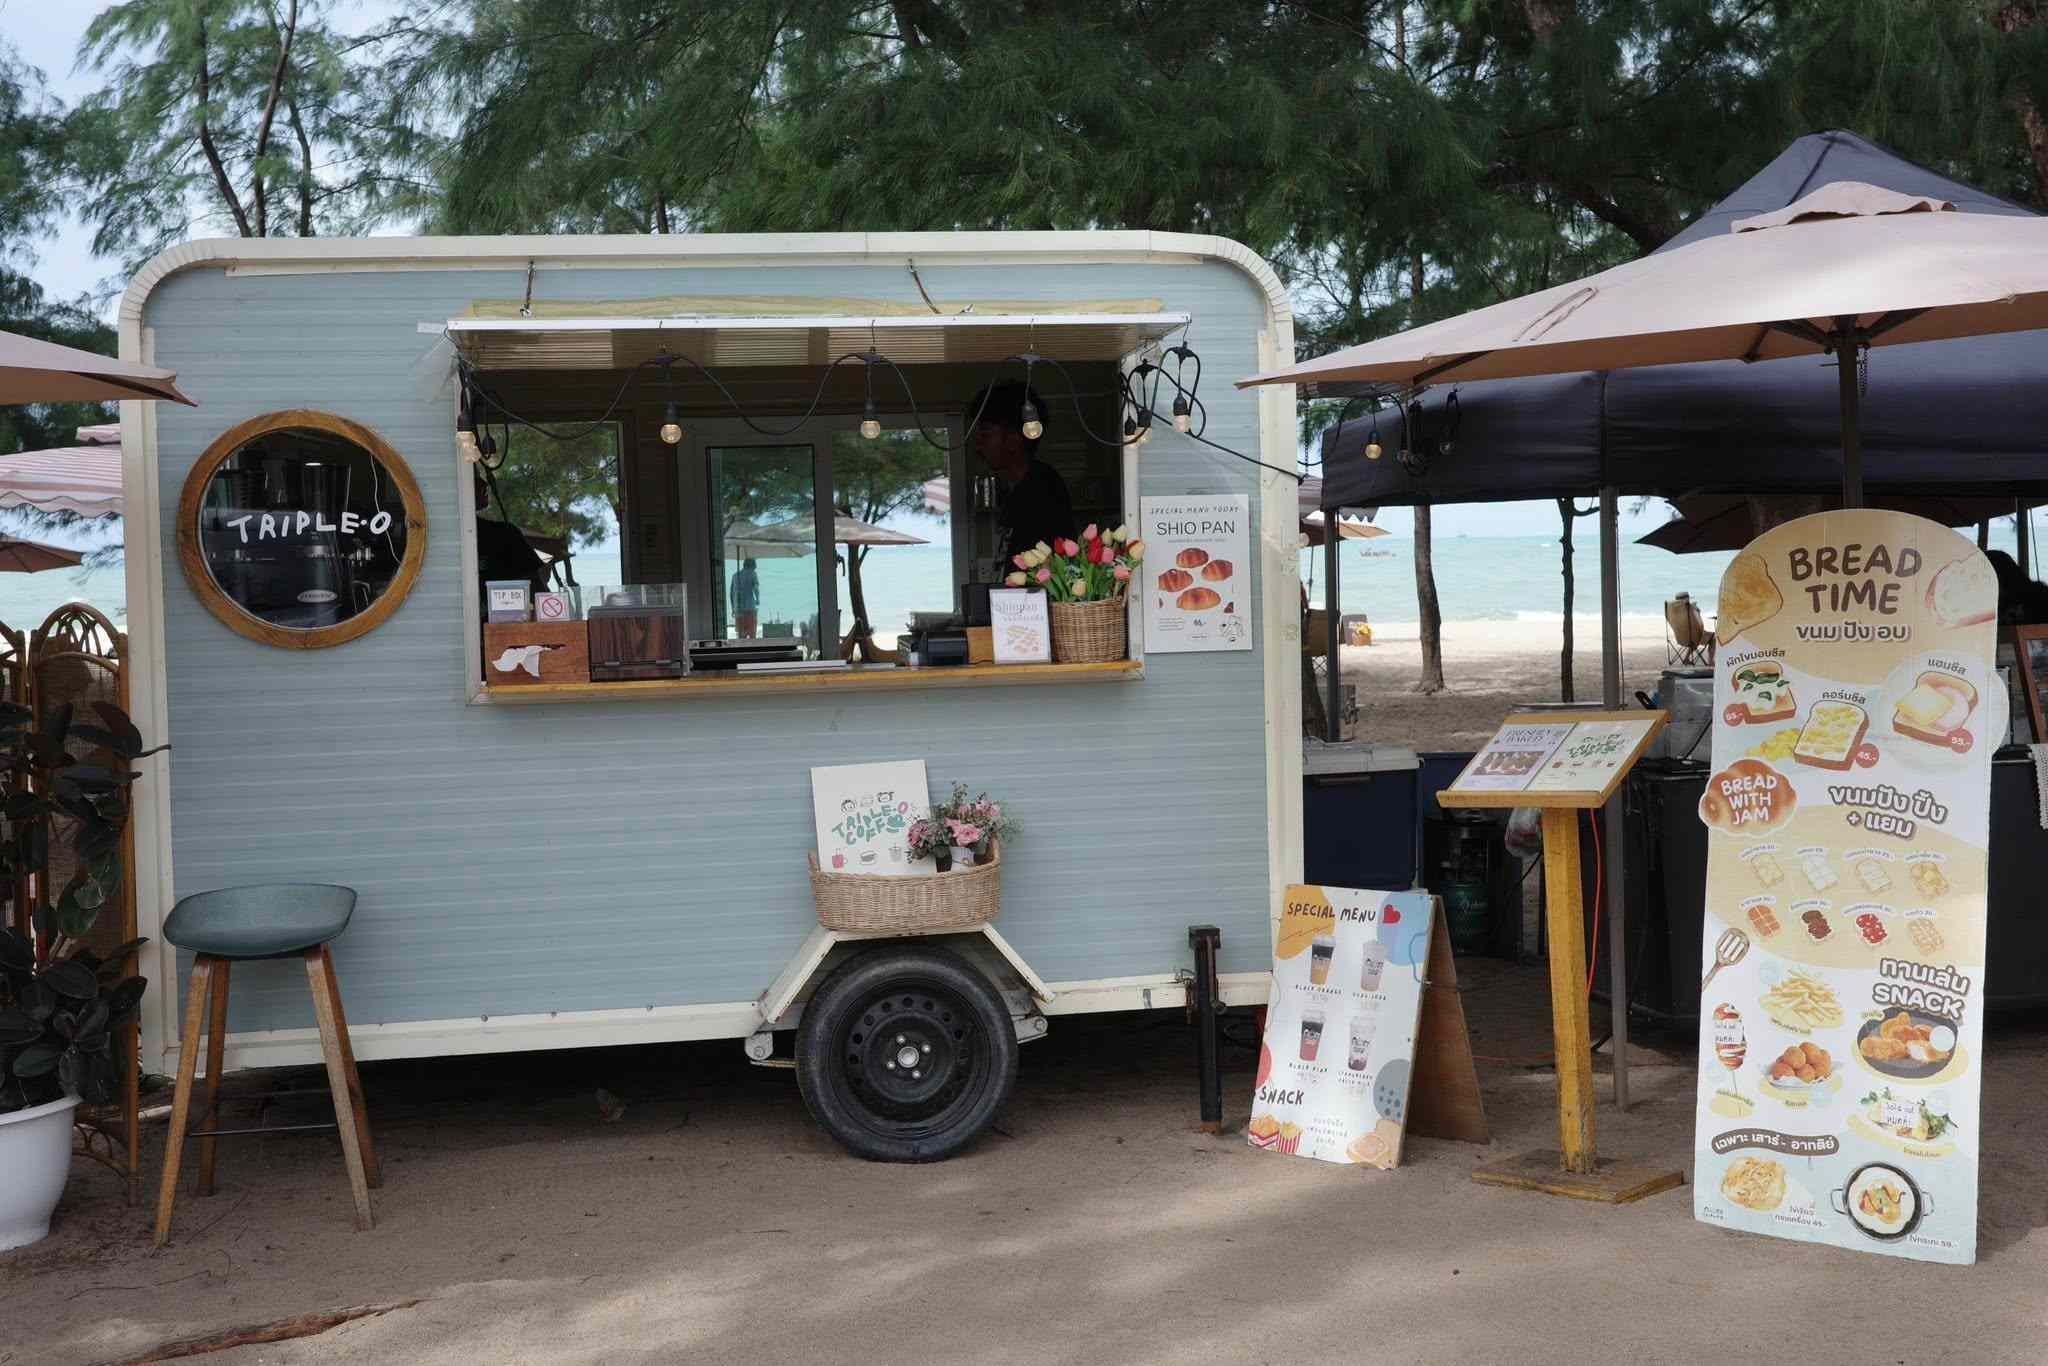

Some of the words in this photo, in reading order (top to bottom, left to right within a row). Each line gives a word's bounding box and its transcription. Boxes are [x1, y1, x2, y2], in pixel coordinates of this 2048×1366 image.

[1157, 521, 1197, 536] SHIO
[1202, 520, 1235, 534] PAN
[1788, 543, 1922, 582] BREAD
[1804, 578, 1901, 615] TIME
[1720, 775, 1777, 794] BREAD
[1729, 792, 1772, 807] WITH
[1732, 808, 1769, 825] JAM
[1288, 902, 1336, 918] SPECIAL
[1340, 907, 1376, 923] MENU
[1880, 957, 1970, 996] ทานเล่น
[1872, 982, 1966, 1020] SNACK
[1259, 1086, 1304, 1105] SNACK
